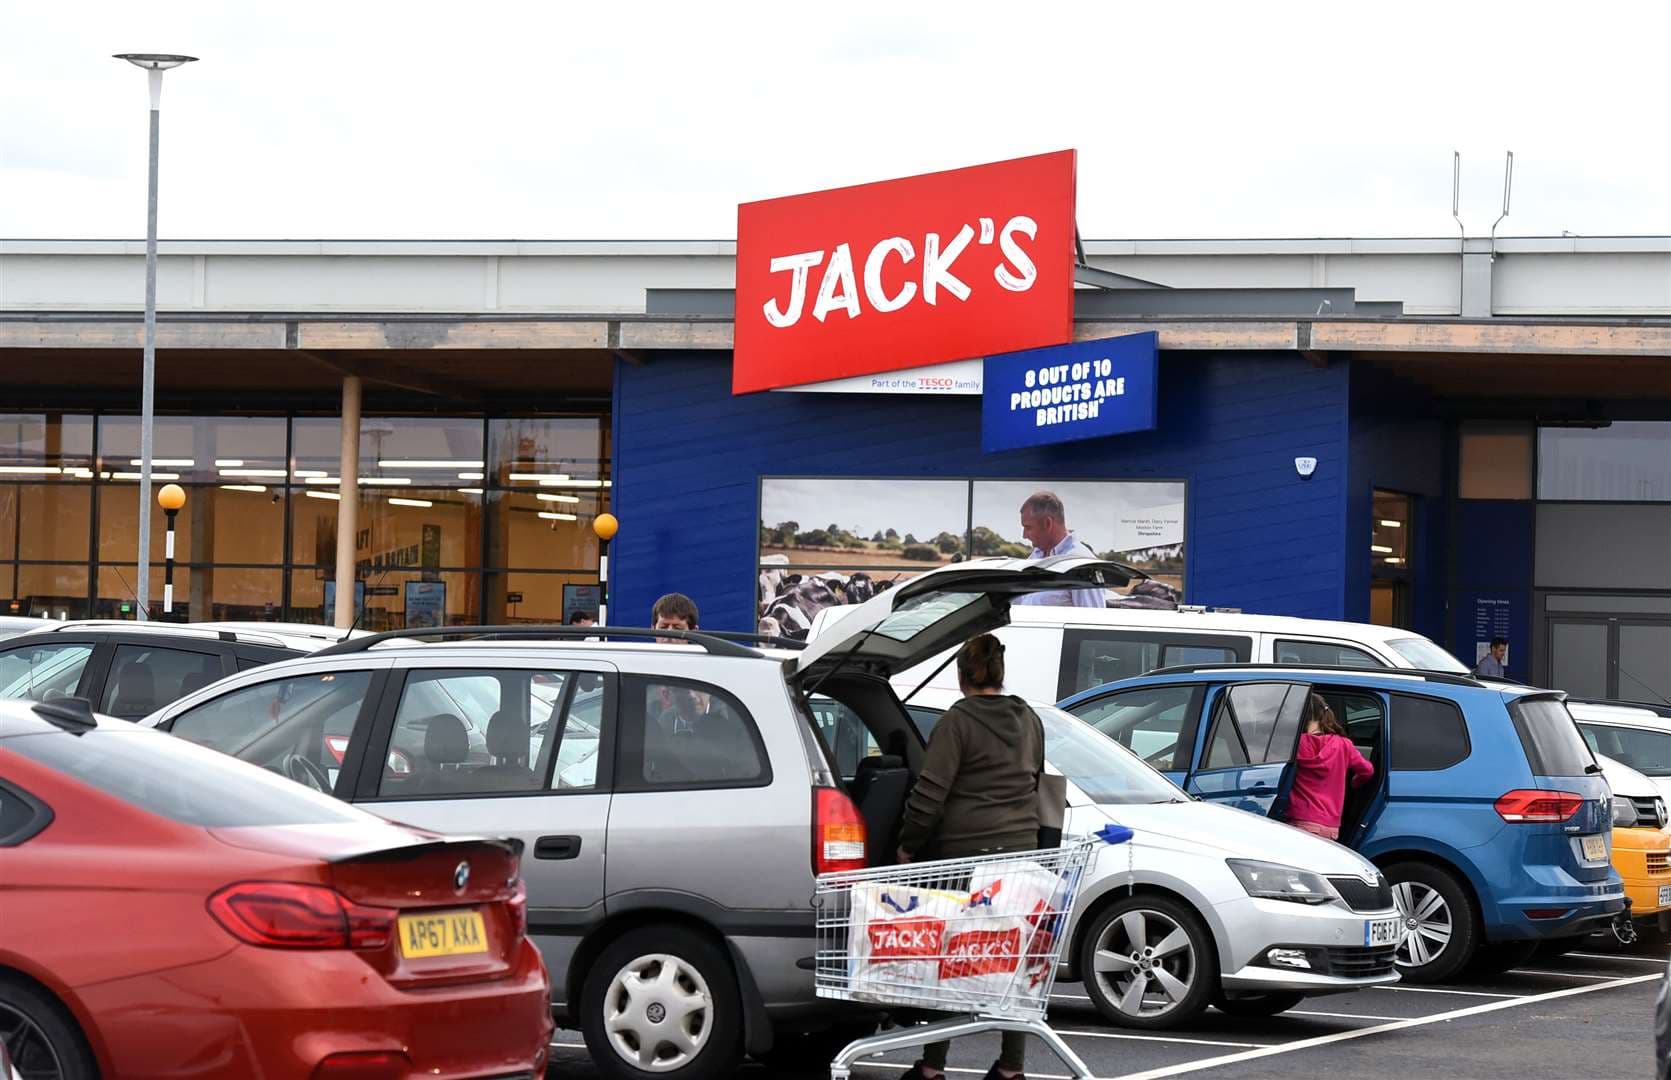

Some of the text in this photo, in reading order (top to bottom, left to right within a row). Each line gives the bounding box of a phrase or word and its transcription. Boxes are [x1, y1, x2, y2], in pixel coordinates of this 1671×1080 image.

[763, 216, 1038, 328] JACK'S
[871, 378, 980, 390] Part of the TESCO family
[1025, 359, 1112, 387] 8 OUT OF 10
[1011, 377, 1125, 411] PRODUCTS ARE
[409, 916, 480, 951] AP67 AXA
[874, 930, 937, 950] JACK'S
